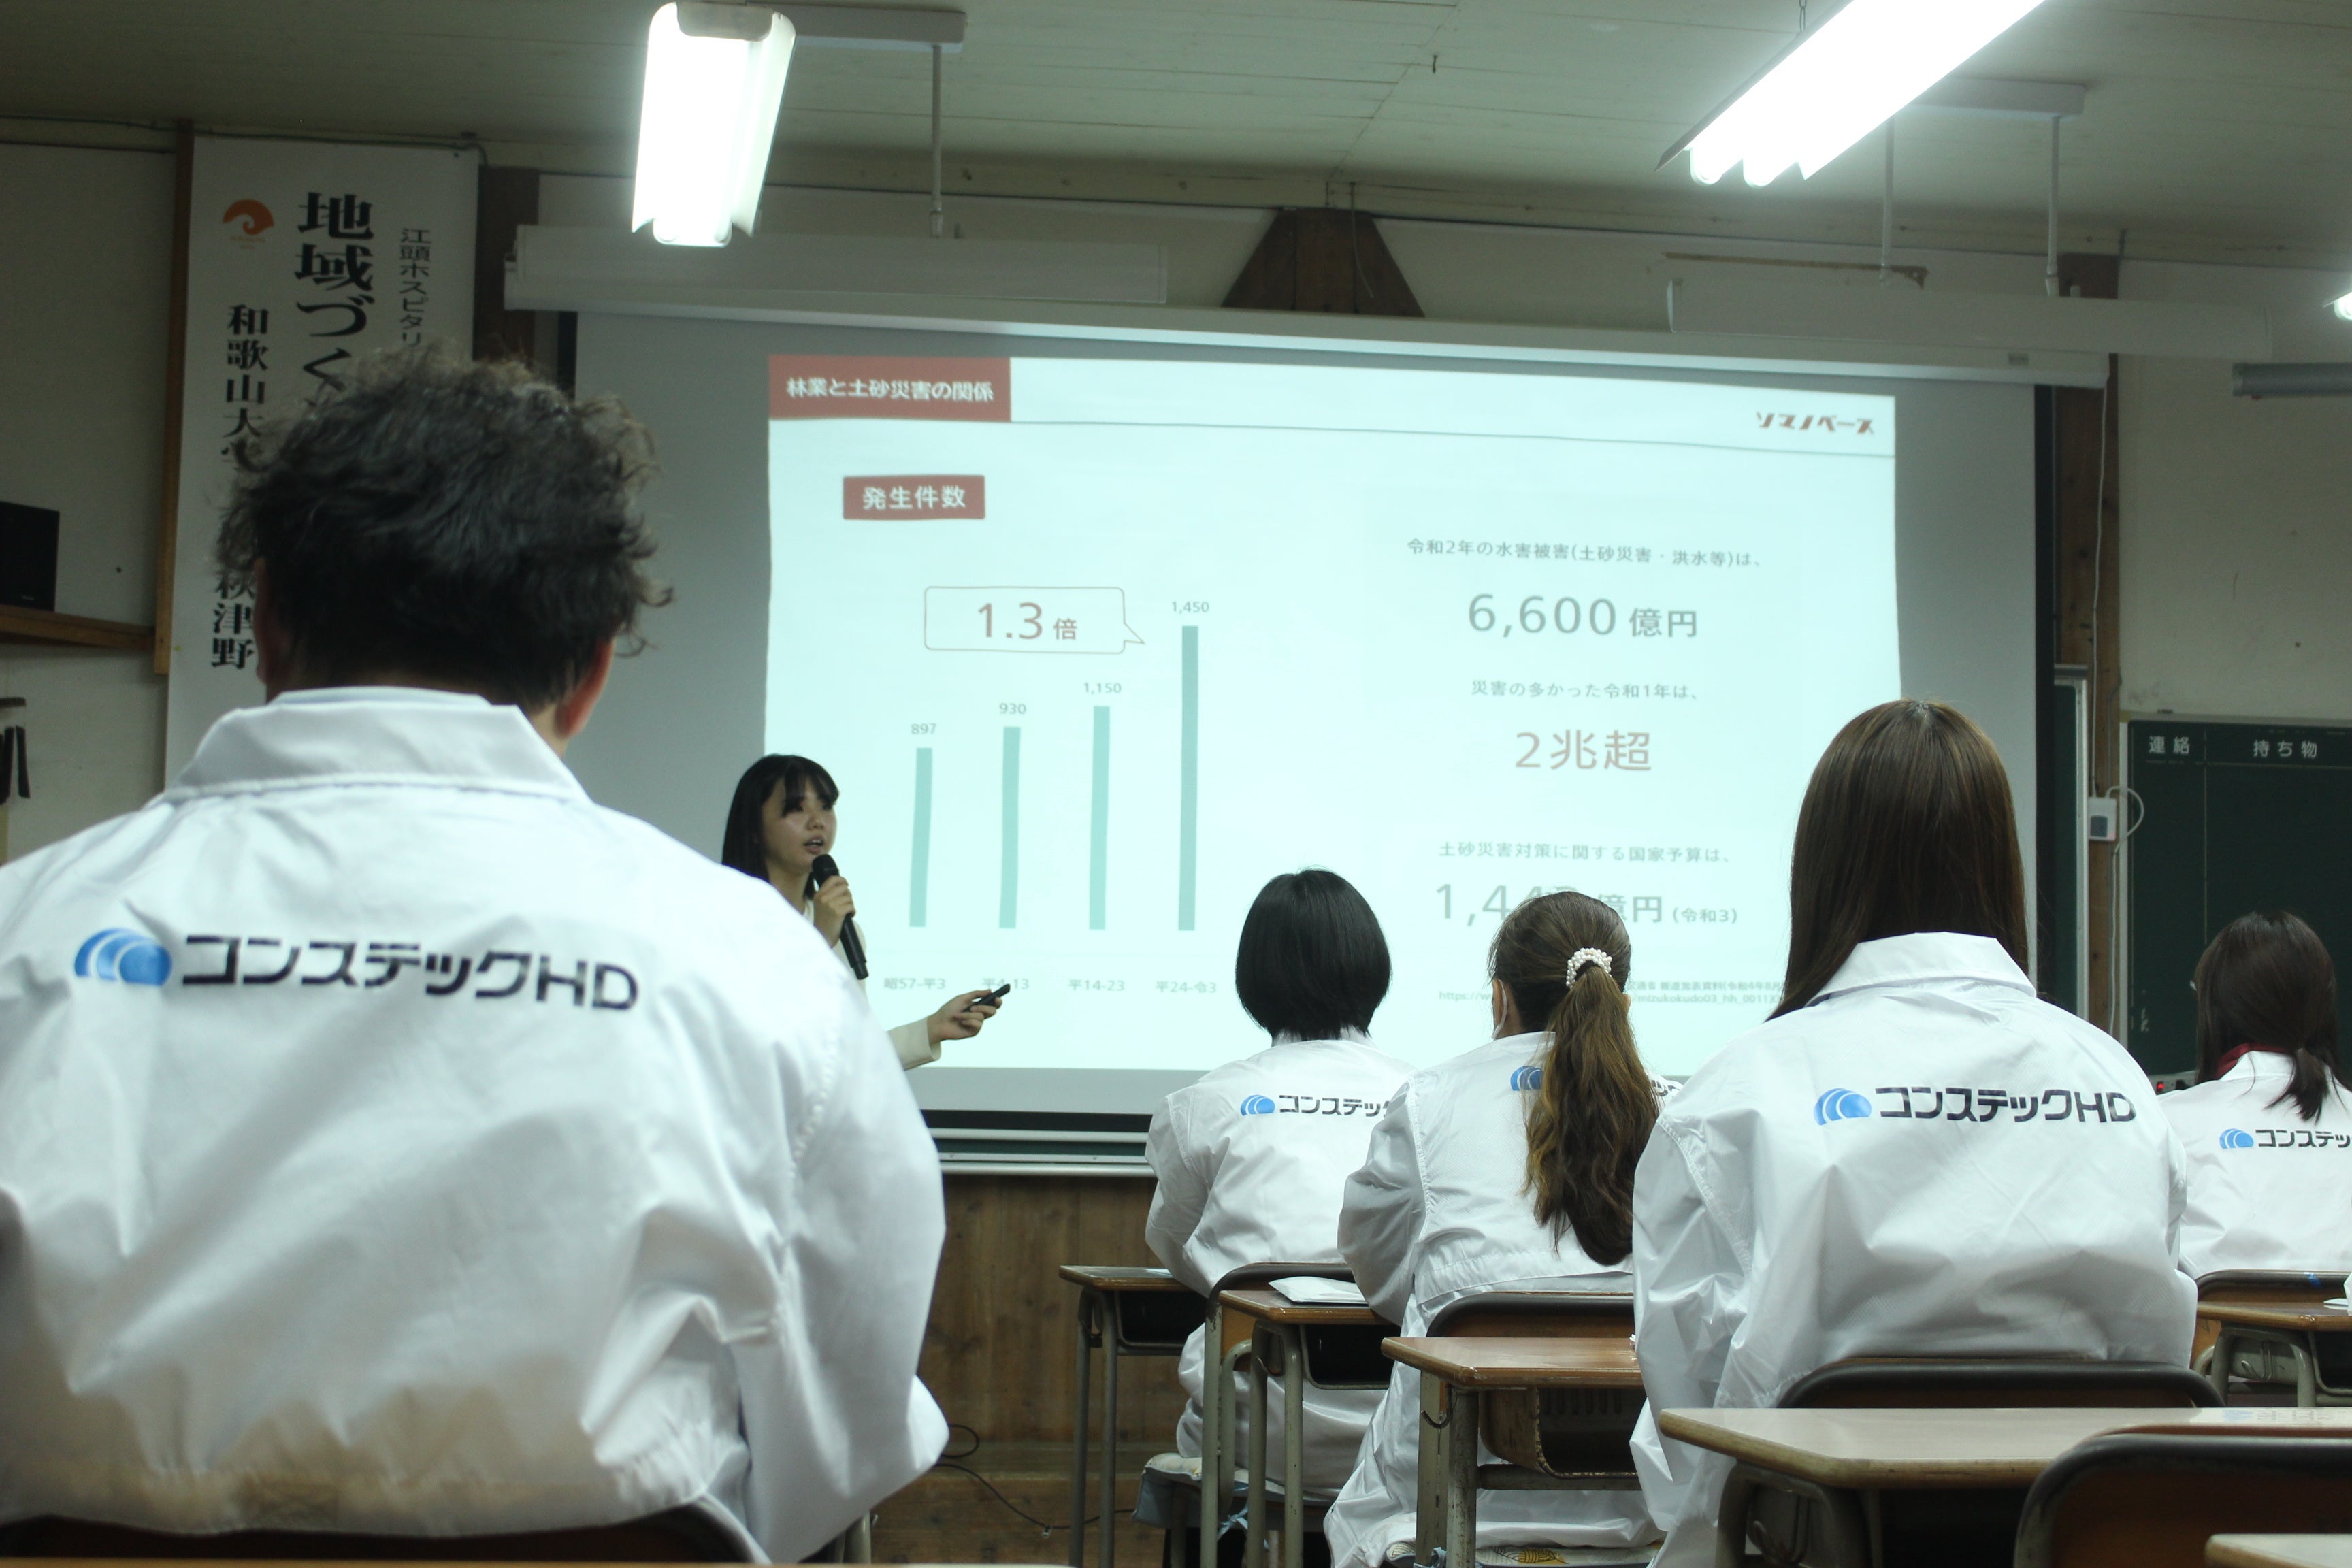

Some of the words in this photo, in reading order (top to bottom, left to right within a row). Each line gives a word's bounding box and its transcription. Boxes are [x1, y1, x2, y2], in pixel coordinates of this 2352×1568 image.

[294, 191, 375, 407] 地域づく
[787, 377, 994, 403] 林業と土砂災害の関係
[1756, 412, 1875, 434] ソマノベース
[862, 485, 966, 510] 発生件数
[1171, 601, 1211, 615] 1,450
[1083, 681, 1123, 695] 1,150
[1471, 679, 1699, 701] 災害の多かった令和1年は、
[998, 702, 1027, 715] 930
[911, 722, 937, 736] 897
[1515, 728, 1652, 772] 2兆超
[2148, 734, 2191, 756] 連絡
[2252, 738, 2319, 760] 持ち物
[1438, 840, 1730, 864] 土砂災害対策に関する国家予算は、
[182, 934, 638, 1011] コンステックHD
[1068, 979, 1126, 992] 平14-23
[1874, 1086, 2137, 1124] コンステックHD
